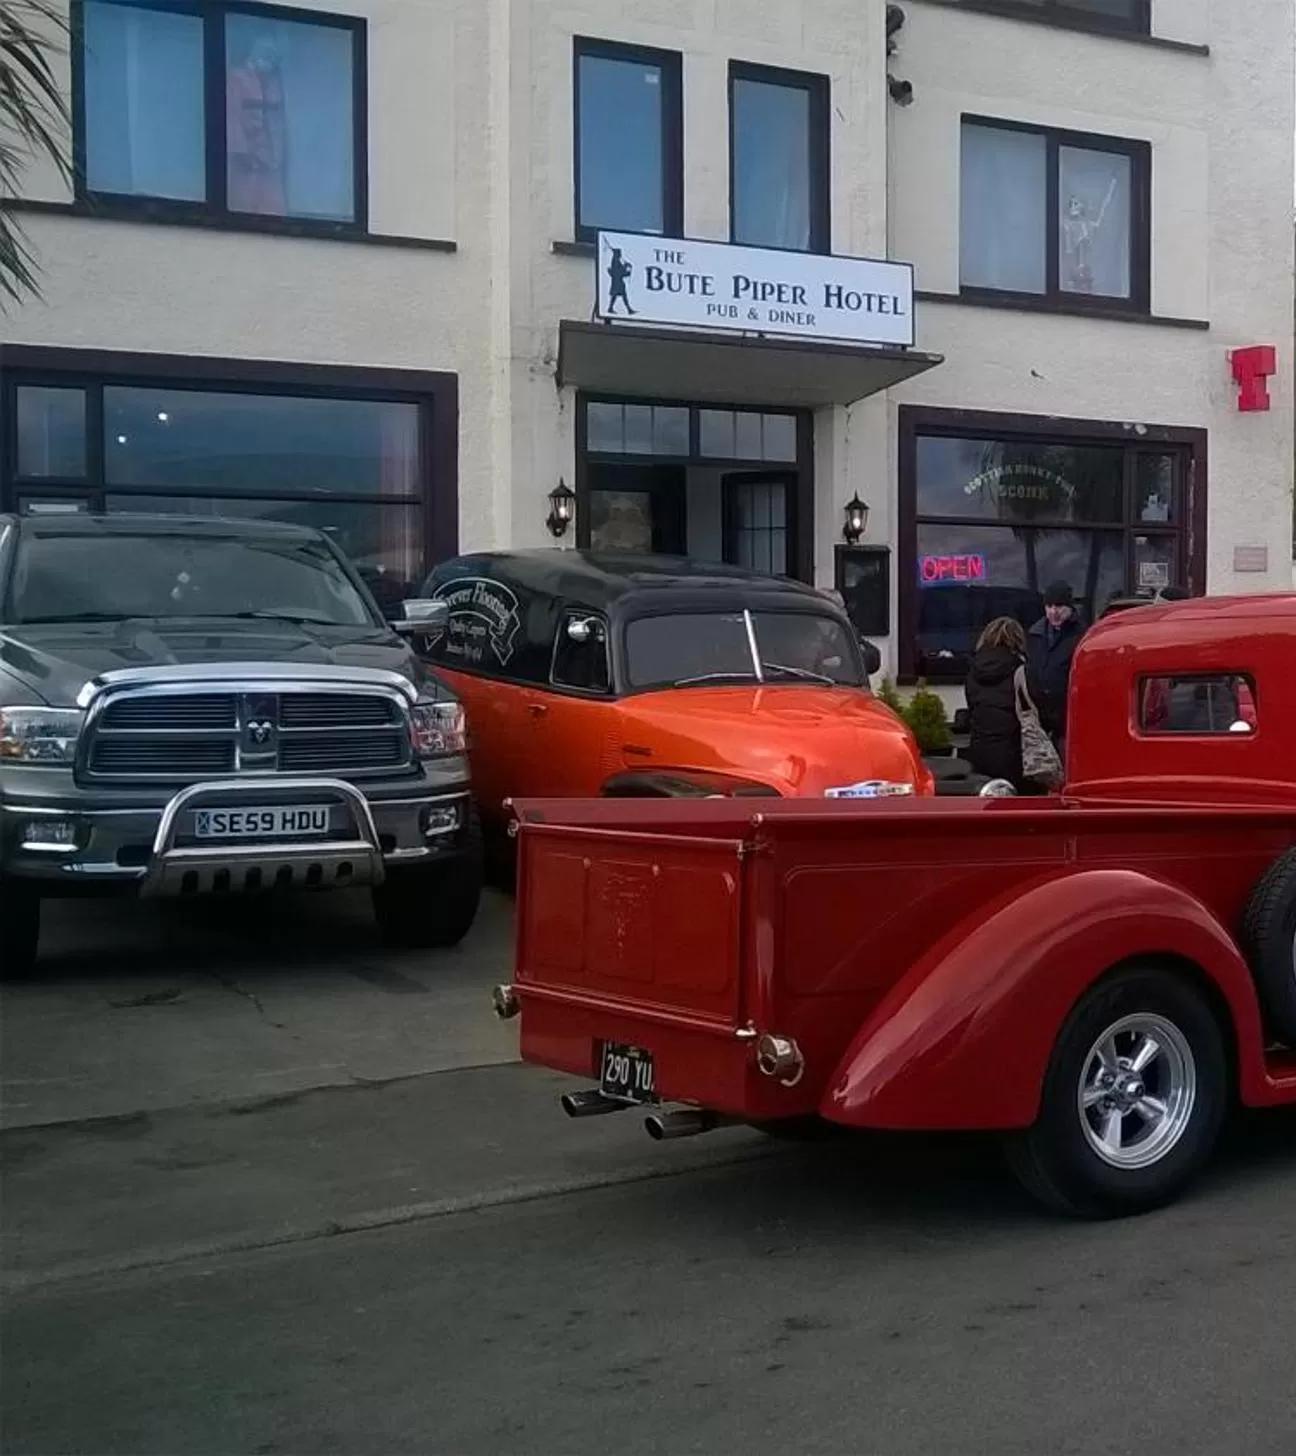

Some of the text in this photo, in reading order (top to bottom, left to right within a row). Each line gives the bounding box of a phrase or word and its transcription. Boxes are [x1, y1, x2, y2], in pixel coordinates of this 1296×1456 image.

[653, 249, 685, 265] THE
[645, 265, 905, 316] BUTE PIPER HOTEL
[706, 302, 816, 327] PUB & DINER
[922, 555, 985, 582] OPEN
[213, 810, 326, 833] SE59 HDU
[605, 1053, 655, 1092] 290 YU
